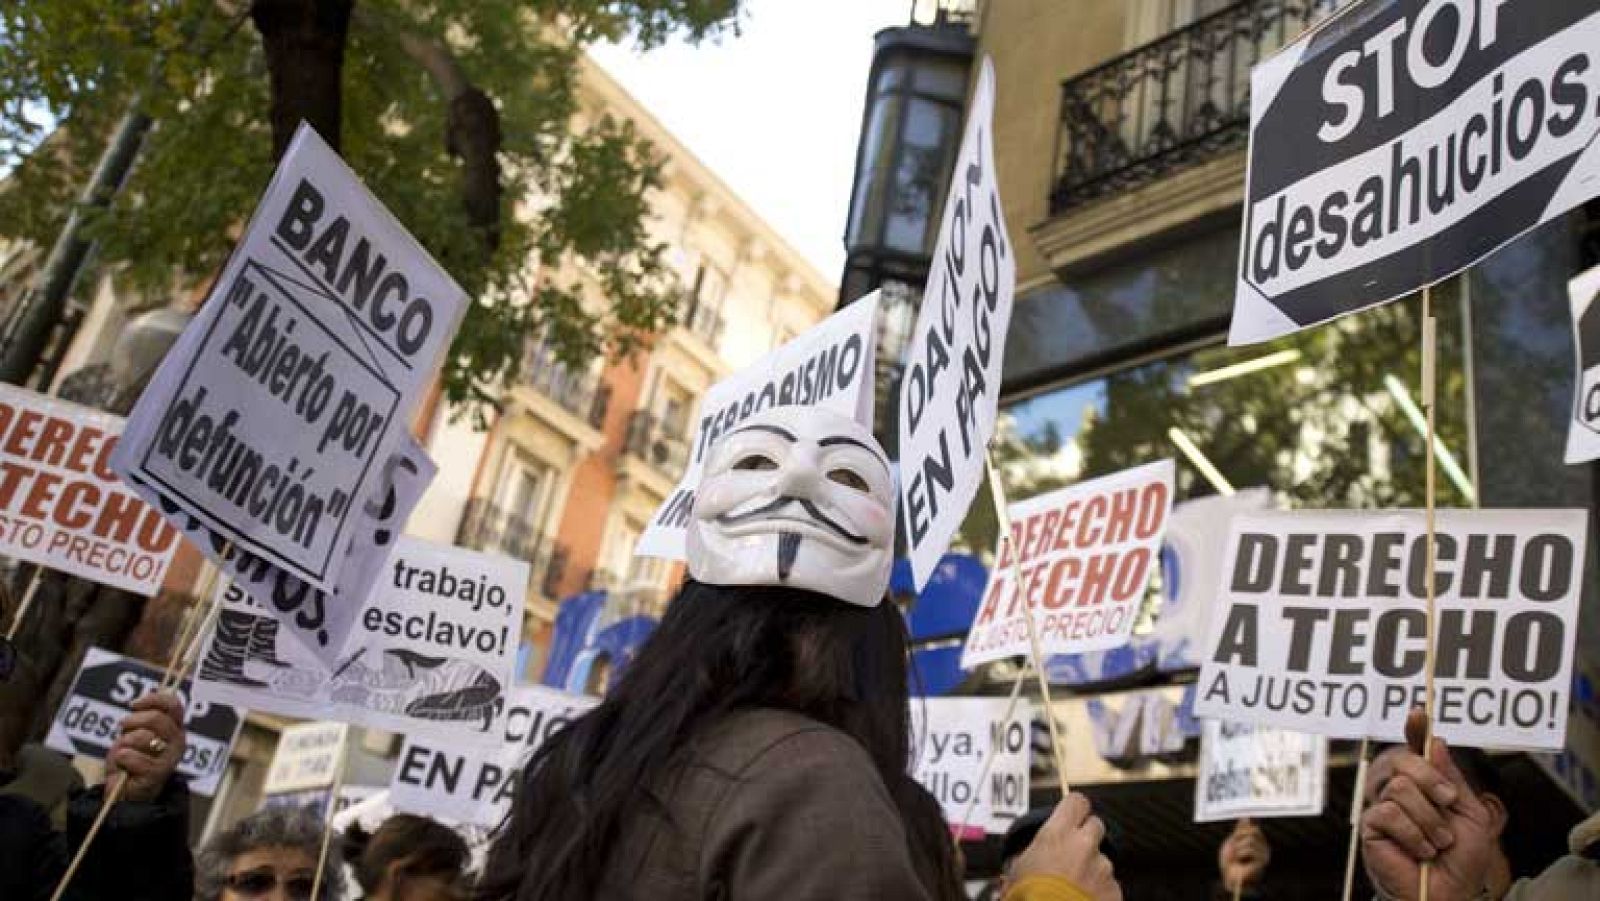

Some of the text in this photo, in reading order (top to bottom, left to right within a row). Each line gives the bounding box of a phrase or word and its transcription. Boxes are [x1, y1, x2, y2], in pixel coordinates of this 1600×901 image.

[1253, 52, 1600, 285] desahucios
[274, 178, 435, 358] BANCO
[222, 277, 334, 424] "Abierto
[316, 389, 384, 459] por
[907, 190, 1005, 551] EN PAGO!
[158, 385, 348, 549] defunción"
[47, 530, 164, 584] PRECIO!
[1000, 480, 1168, 570] DERECHO
[393, 558, 514, 616] trabajo,
[977, 547, 1152, 627] A TECHO
[1229, 532, 1575, 602] DERECHO
[362, 606, 510, 656] esclavo!
[1213, 602, 1566, 683] A TECHO
[1204, 670, 1231, 704] A
[1241, 674, 1369, 719] JUSTO
[399, 744, 466, 795] EN
